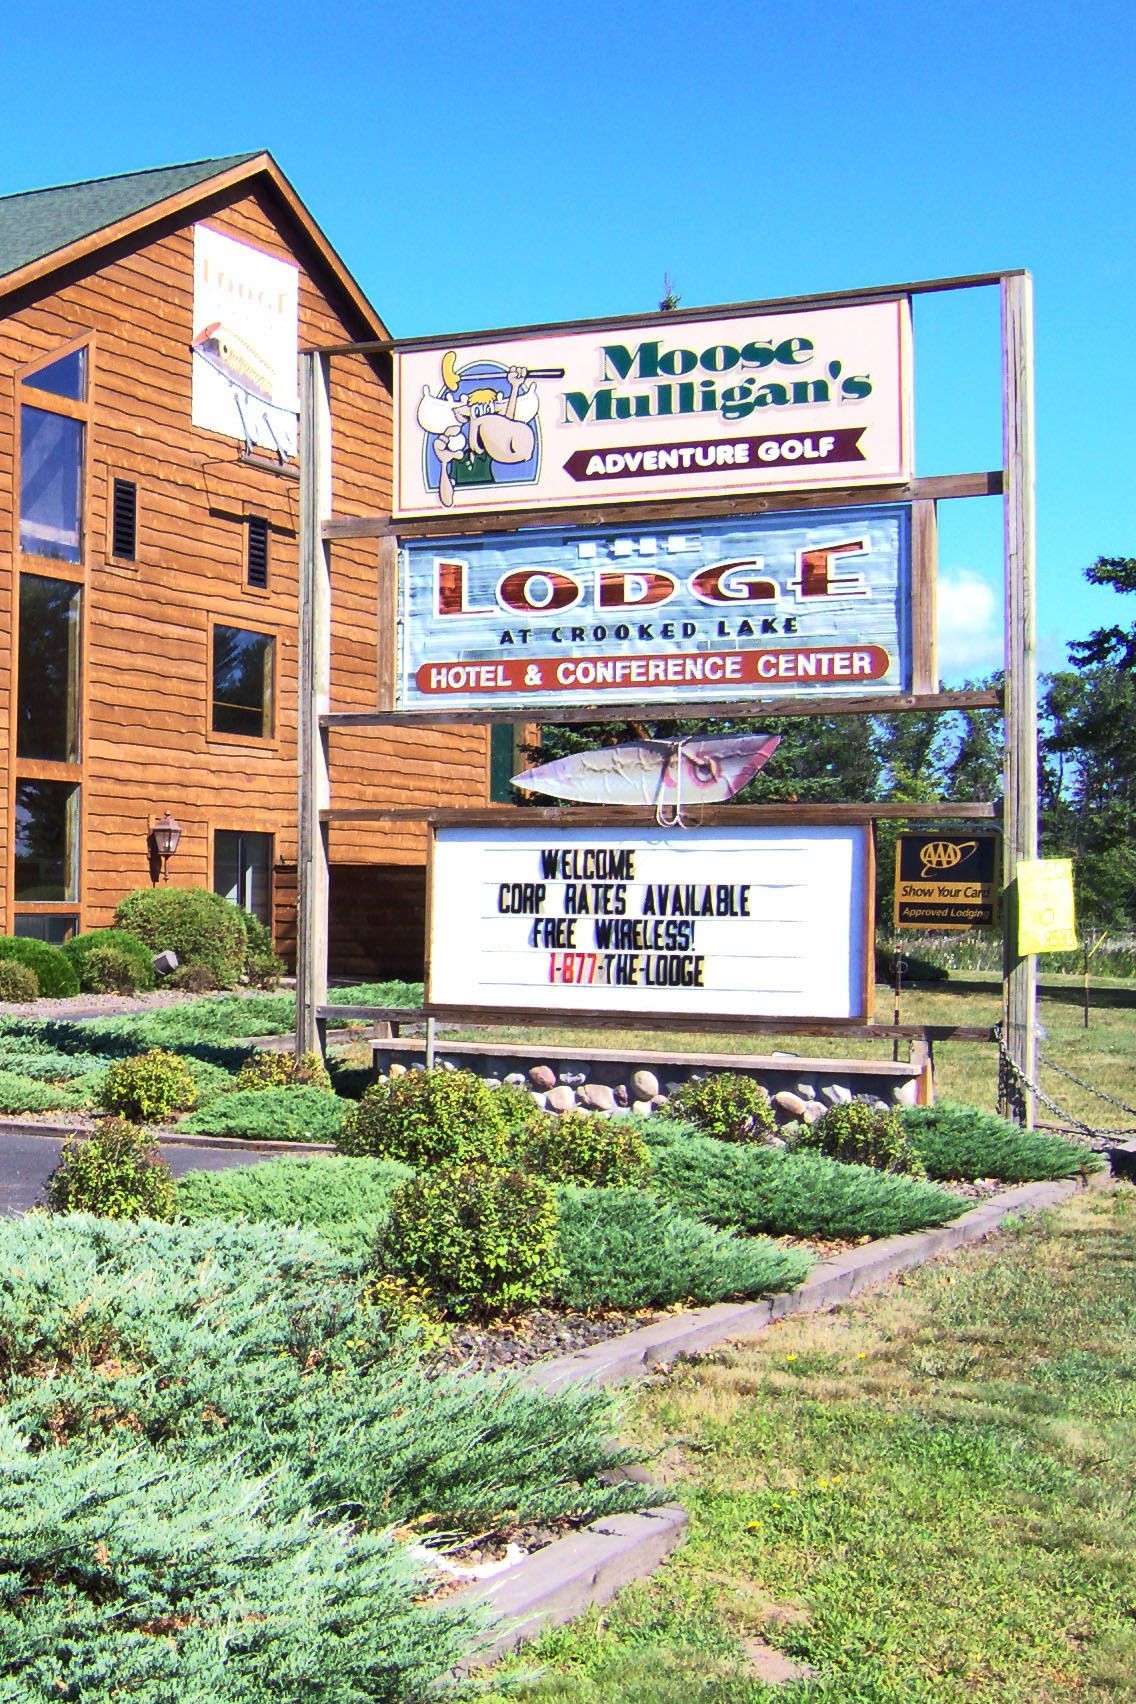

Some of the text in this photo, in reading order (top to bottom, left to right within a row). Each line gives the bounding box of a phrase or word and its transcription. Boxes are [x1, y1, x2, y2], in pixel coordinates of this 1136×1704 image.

[601, 336, 815, 382] Moose
[561, 360, 873, 424] Mulligan's
[585, 436, 836, 476] ADVENTURE GOLF
[431, 535, 872, 619] LODGE
[500, 616, 799, 646] AT CROOKED LAKE
[430, 650, 872, 689] HOTEL & CONFERENCE CENTER
[541, 849, 635, 880] WELCOME
[922, 842, 960, 868] AAA
[498, 883, 751, 916] CORP RATES AVAILABLE
[902, 885, 989, 898] Show Your Card
[903, 907, 989, 920] Approved Lodging
[533, 917, 695, 951] FREE WIRELESS!
[548, 952, 704, 987] 1-877-THE-LODGE
